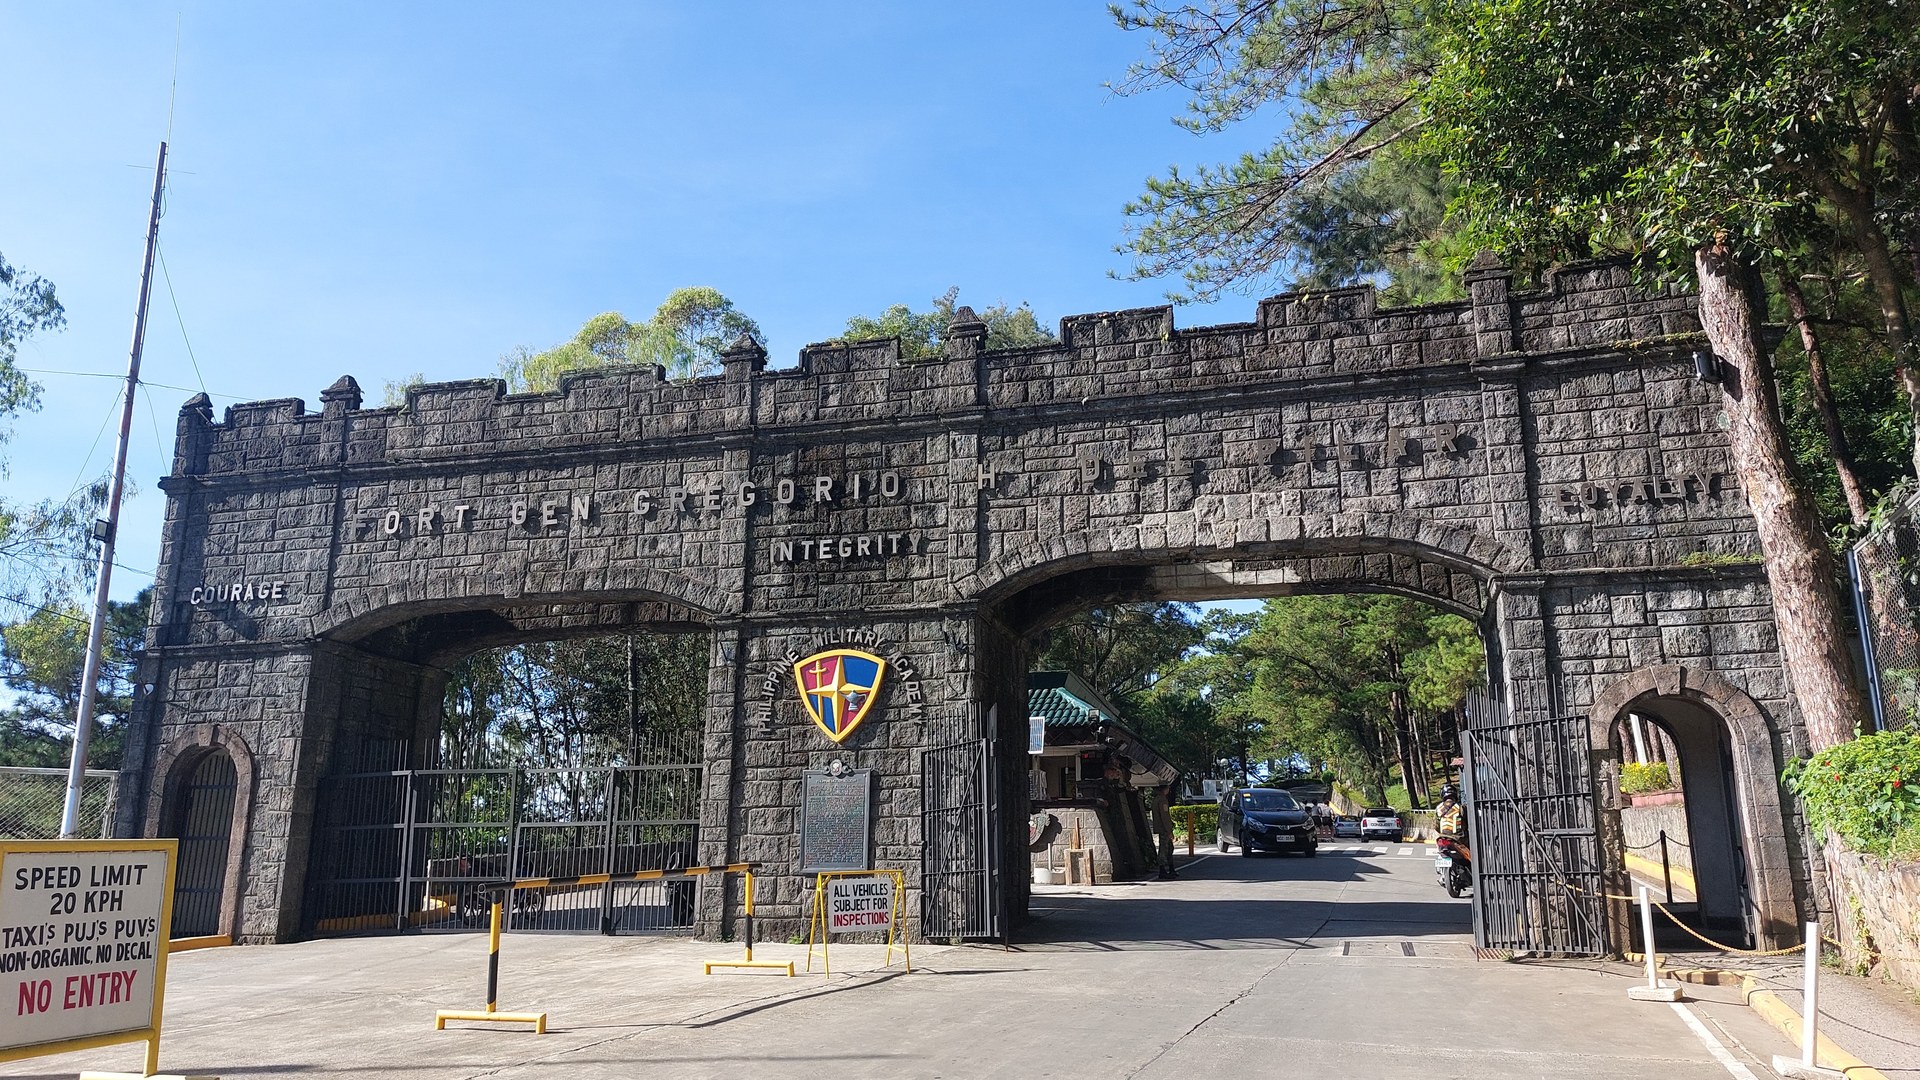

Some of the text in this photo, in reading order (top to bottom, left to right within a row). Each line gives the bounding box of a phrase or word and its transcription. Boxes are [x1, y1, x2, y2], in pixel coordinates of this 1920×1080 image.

[350, 424, 1458, 542] FORT GEN GREGORIO H DEL PILAR
[1555, 471, 1713, 507] LOYALTY
[769, 534, 922, 562] INTEGRITY
[190, 581, 285, 605] COURAGE
[757, 628, 923, 732] PHILIPPINE MILITARY ACADEMY
[15, 865, 147, 890] SPEED LIMIT
[834, 882, 889, 898] ALL VEHICLES
[50, 890, 123, 915] 20 KPH
[834, 897, 888, 913] SUBJECT FOR
[833, 911, 889, 927] INSPECTIONS
[96, 944, 112, 964] NO
[116, 941, 152, 962] DECAL
[18, 970, 138, 1016] NO ENTRY
